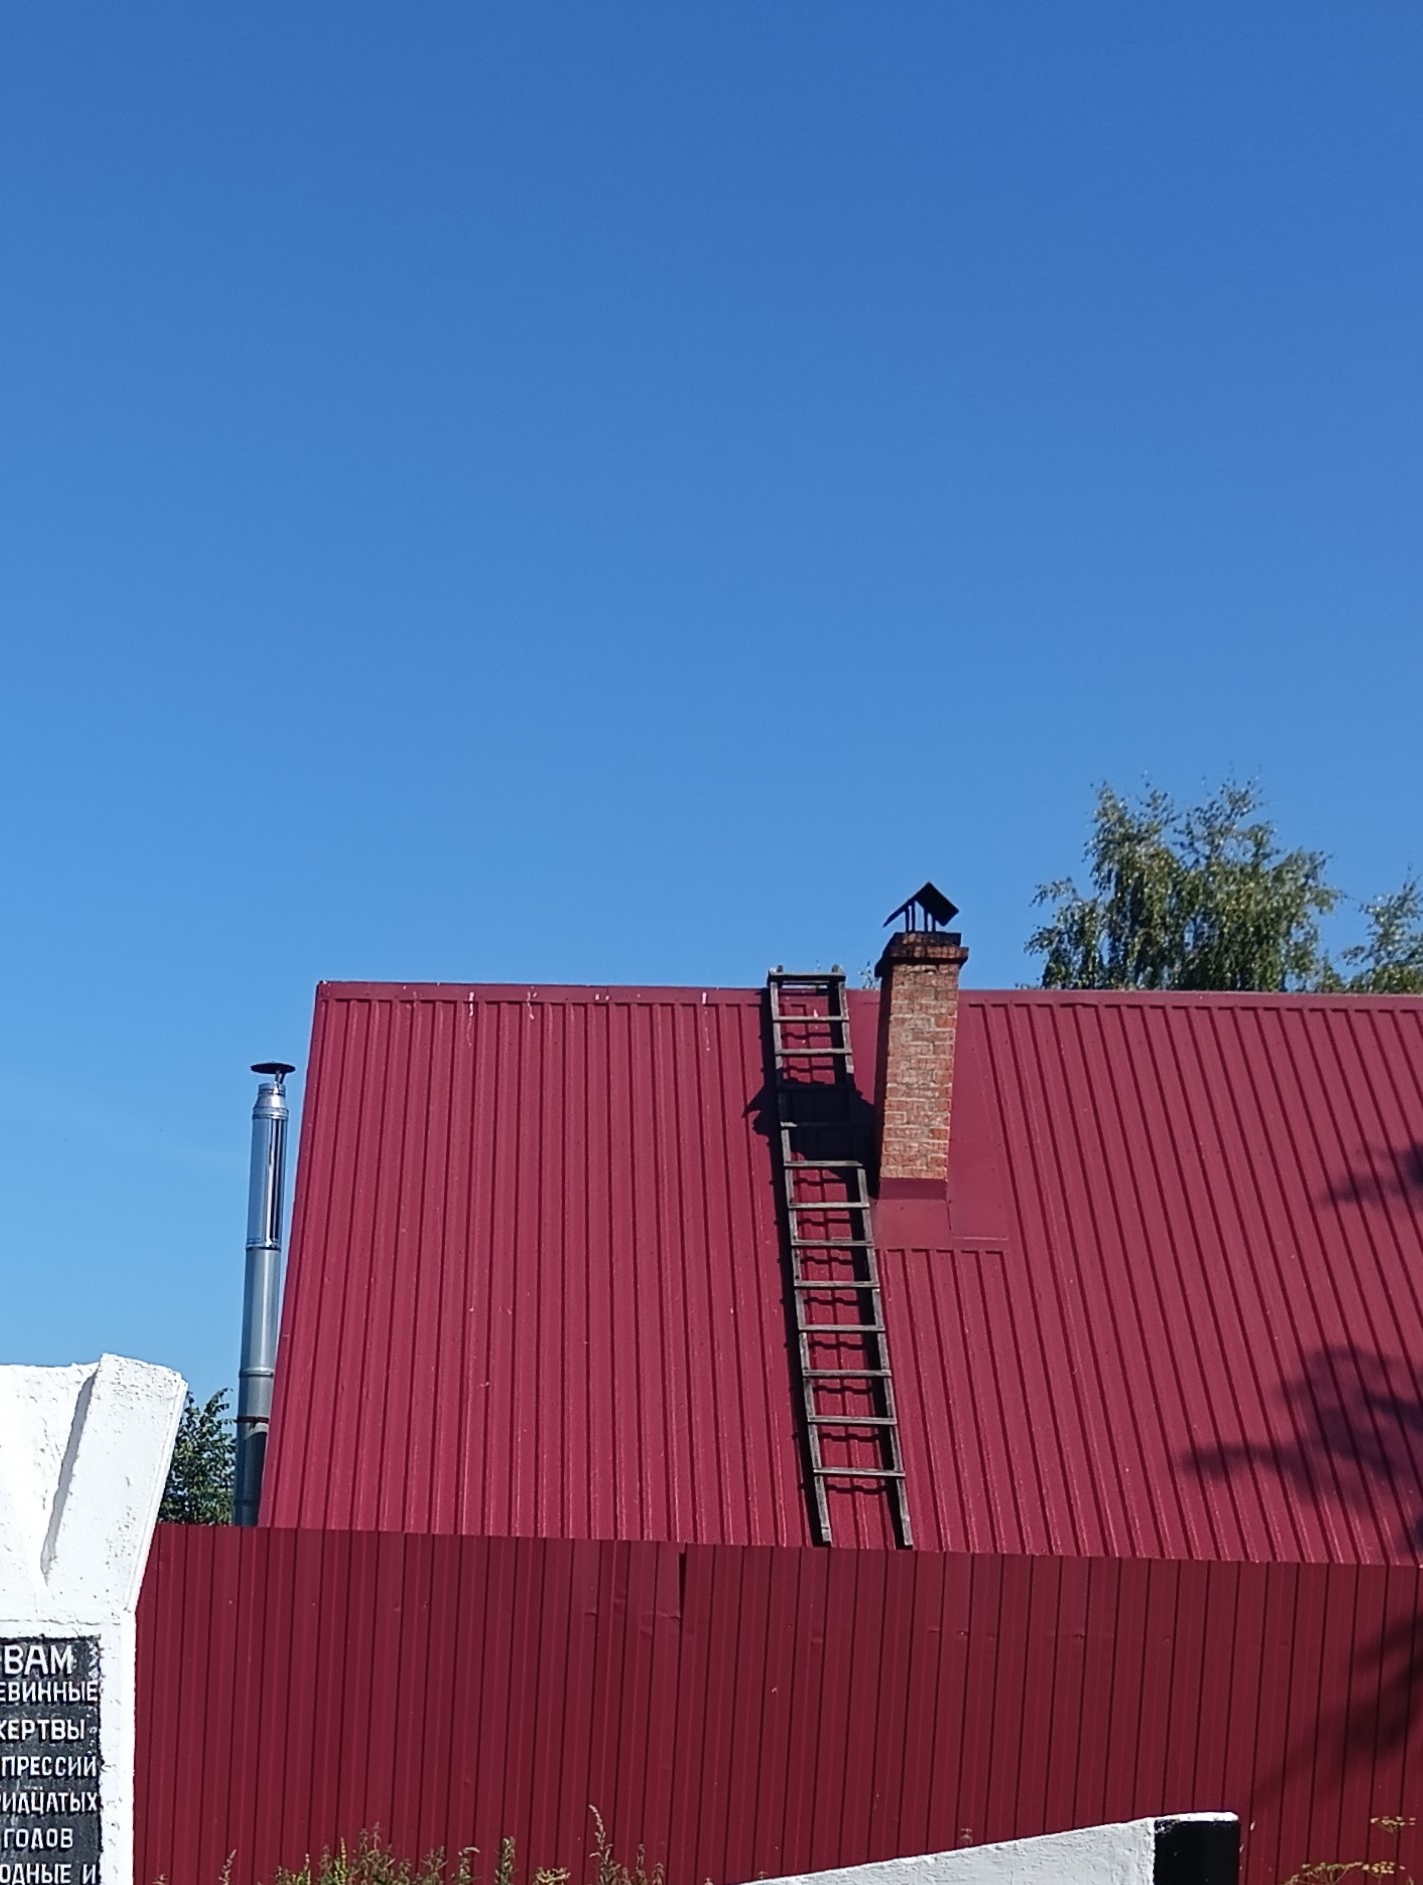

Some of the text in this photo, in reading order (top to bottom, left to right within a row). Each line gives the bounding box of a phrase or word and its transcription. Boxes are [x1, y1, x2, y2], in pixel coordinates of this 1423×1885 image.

[3, 1644, 74, 1675] ВАМ
[3, 1828, 73, 1849] ГОДОВ
[82, 1863, 97, 1885] И
